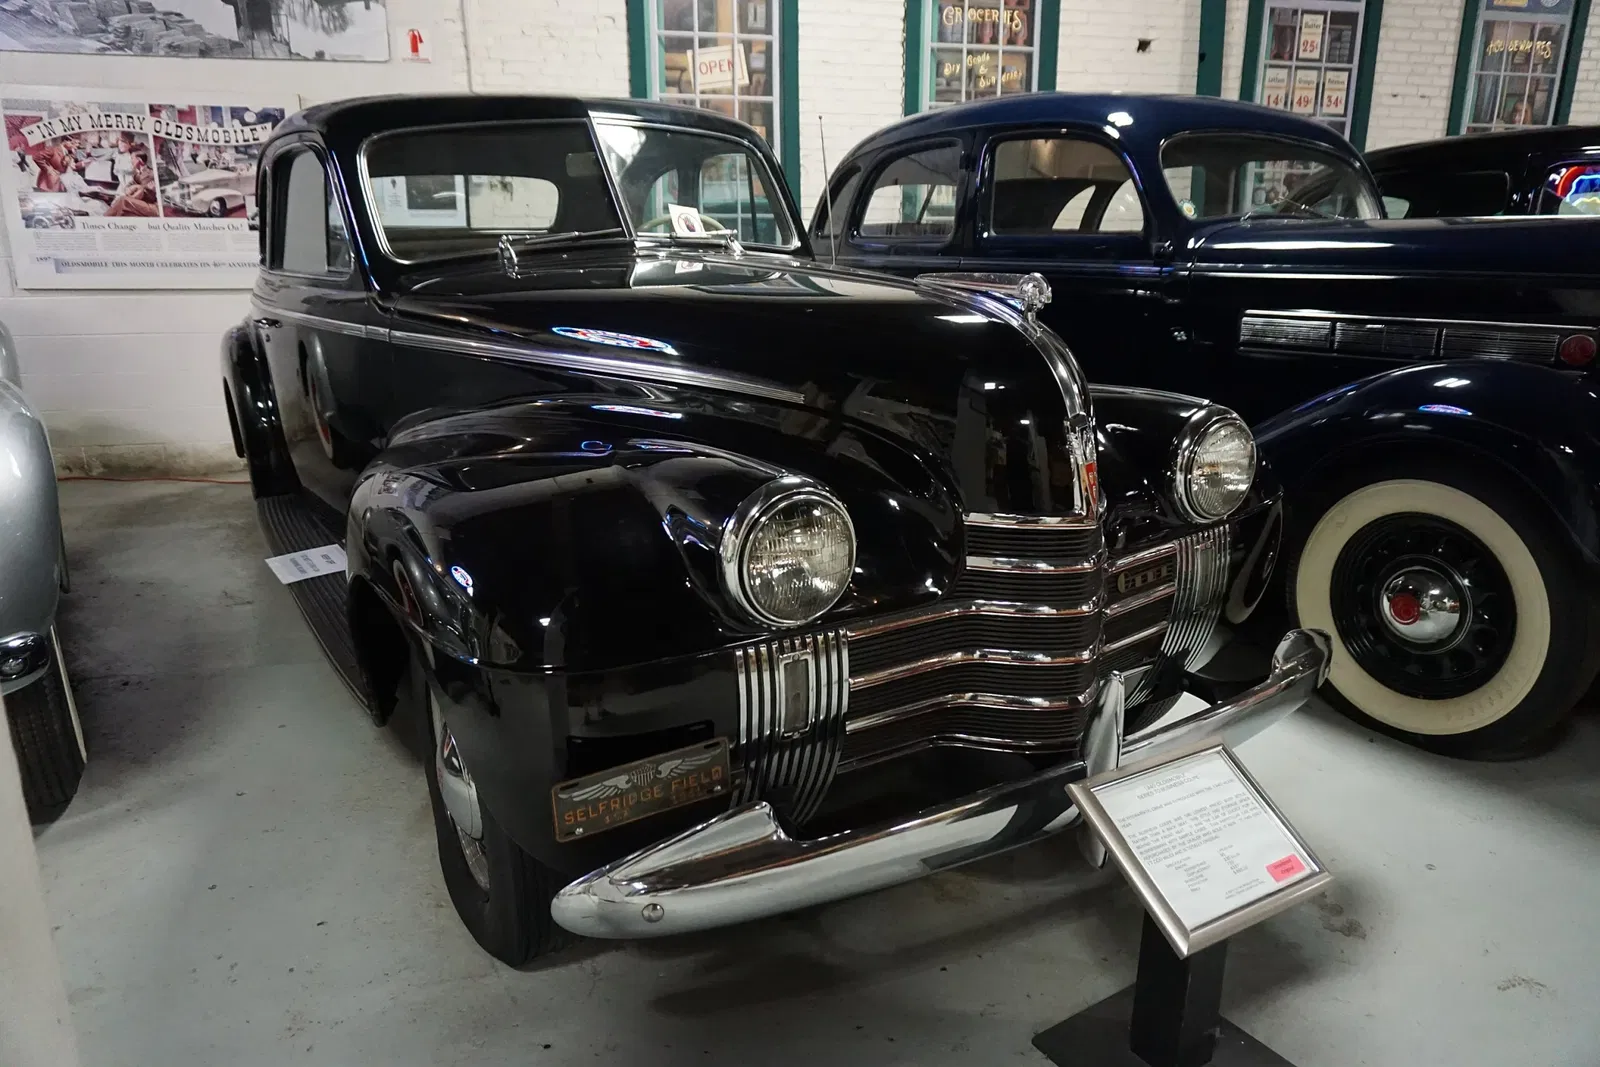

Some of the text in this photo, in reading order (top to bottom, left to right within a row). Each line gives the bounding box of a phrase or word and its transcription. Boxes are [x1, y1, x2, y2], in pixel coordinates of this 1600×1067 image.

[942, 5, 1022, 31] GROCERIES
[699, 58, 734, 75] OPEN
[59, 115, 82, 132] MY
[88, 113, 145, 130] MERRY
[81, 221, 106, 230] Times
[162, 222, 190, 231] Quality
[193, 222, 226, 231] Marches
[564, 785, 663, 824] SELFRIDGE
[671, 766, 722, 791] FIELD
